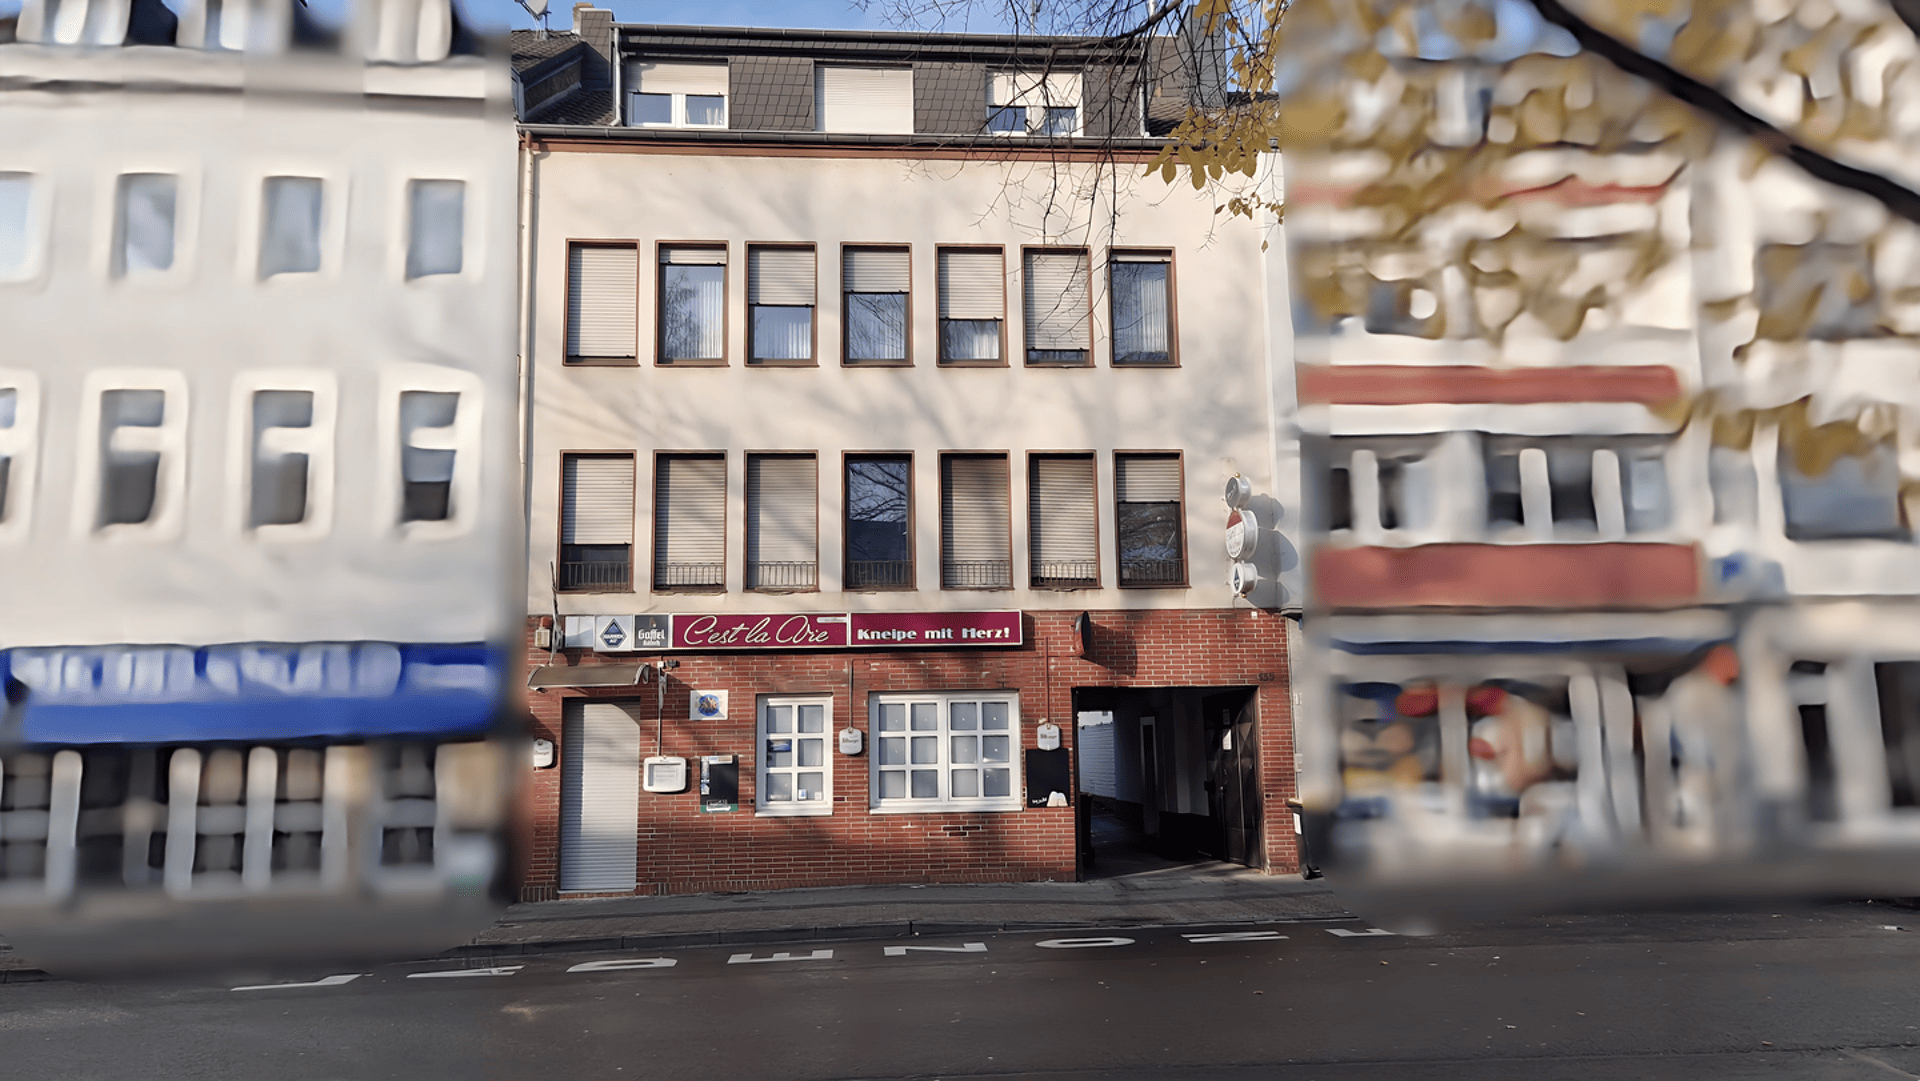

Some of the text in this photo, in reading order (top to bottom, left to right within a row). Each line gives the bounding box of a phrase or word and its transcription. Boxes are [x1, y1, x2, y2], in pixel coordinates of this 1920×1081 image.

[683, 615, 829, 645] C'est la Vie
[857, 626, 1010, 641] Kneipe mit Herz!
